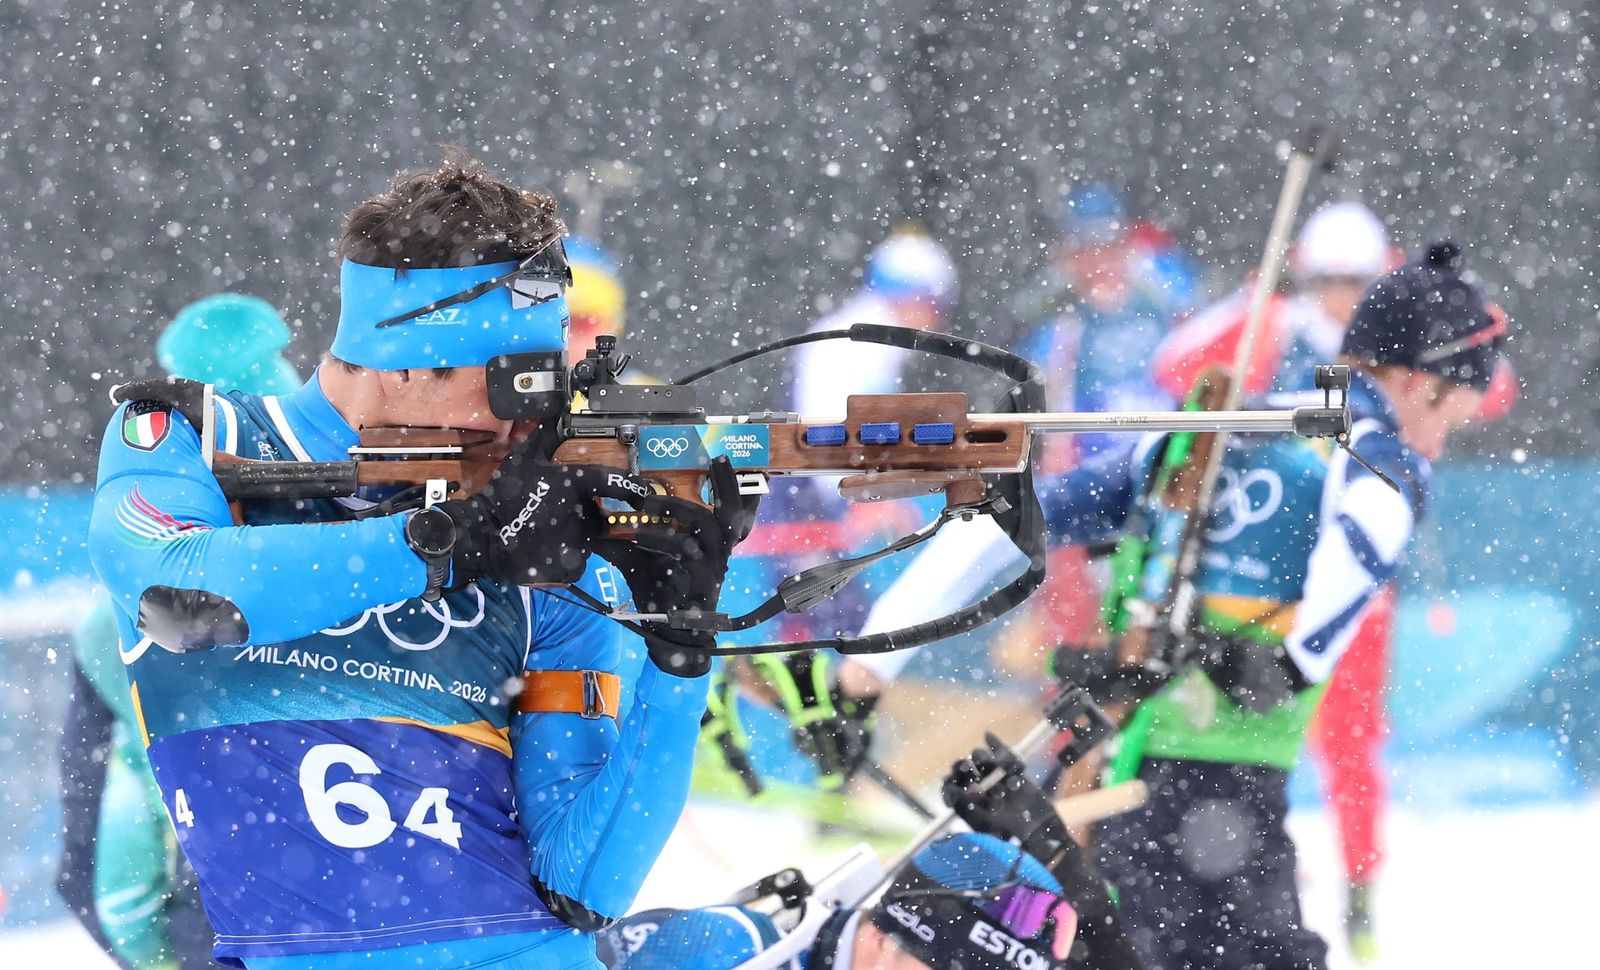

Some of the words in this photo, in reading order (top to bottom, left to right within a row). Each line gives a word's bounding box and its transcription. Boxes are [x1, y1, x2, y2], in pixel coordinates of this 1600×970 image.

[725, 442, 764, 450] CORTINA
[731, 450, 751, 458] 2026
[233, 645, 338, 672] MILANO
[342, 659, 445, 693] CORTINA
[450, 680, 487, 703] 2026
[299, 743, 397, 848] 6
[403, 787, 463, 850] 4
